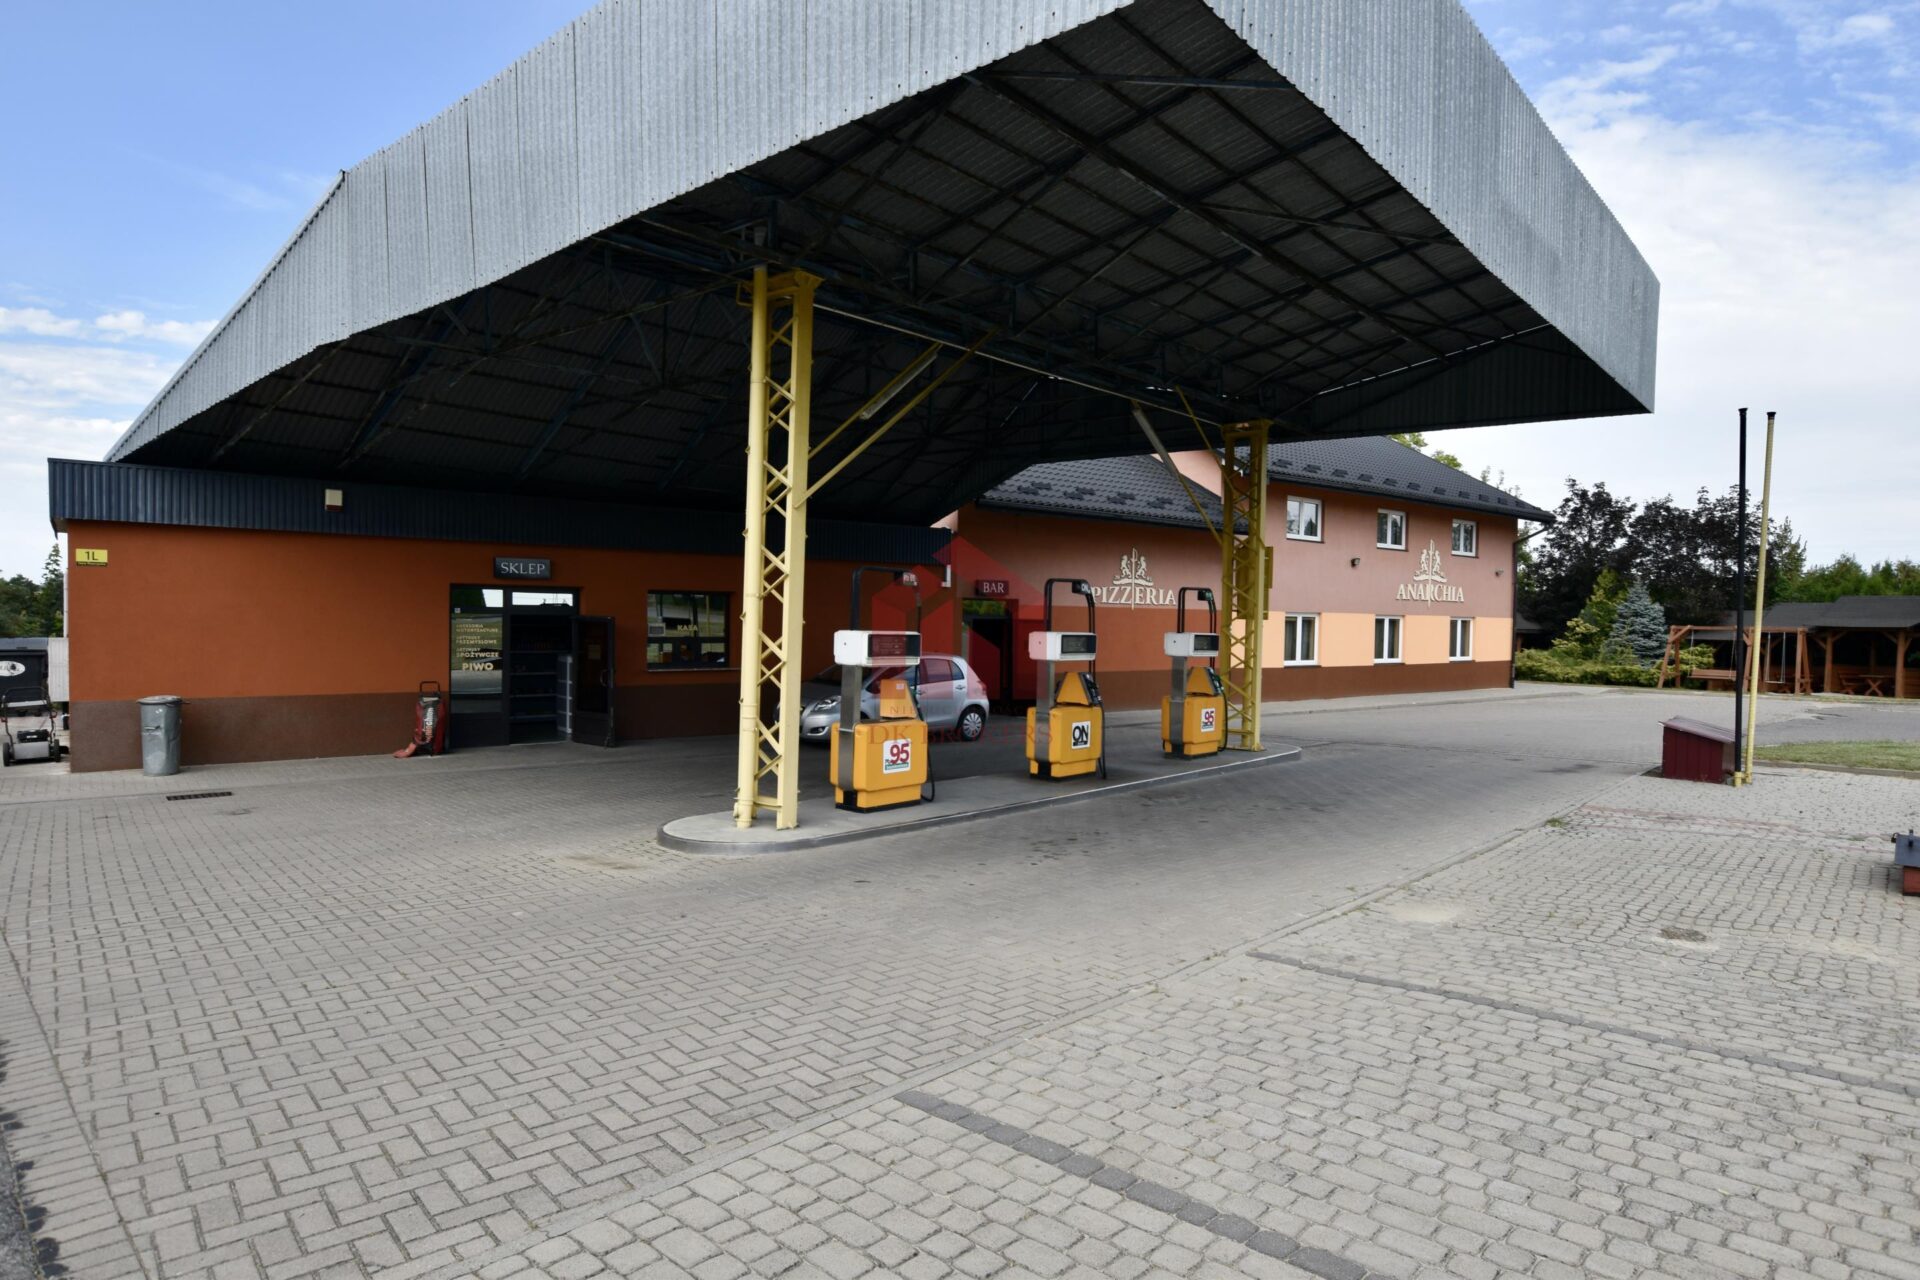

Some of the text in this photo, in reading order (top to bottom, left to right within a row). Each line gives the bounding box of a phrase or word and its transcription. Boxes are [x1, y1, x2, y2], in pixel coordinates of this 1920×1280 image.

[85, 551, 99, 561] 1L
[500, 561, 546, 575] SKLEP
[983, 582, 1004, 593] BAR
[1396, 583, 1465, 602] ANARCHIA
[1091, 585, 1177, 606] PIZZERIA
[677, 624, 698, 632] KASA
[462, 662, 494, 671] PIWO
[1204, 710, 1215, 725] 95
[1072, 724, 1089, 743] ON
[890, 742, 910, 765] 95
